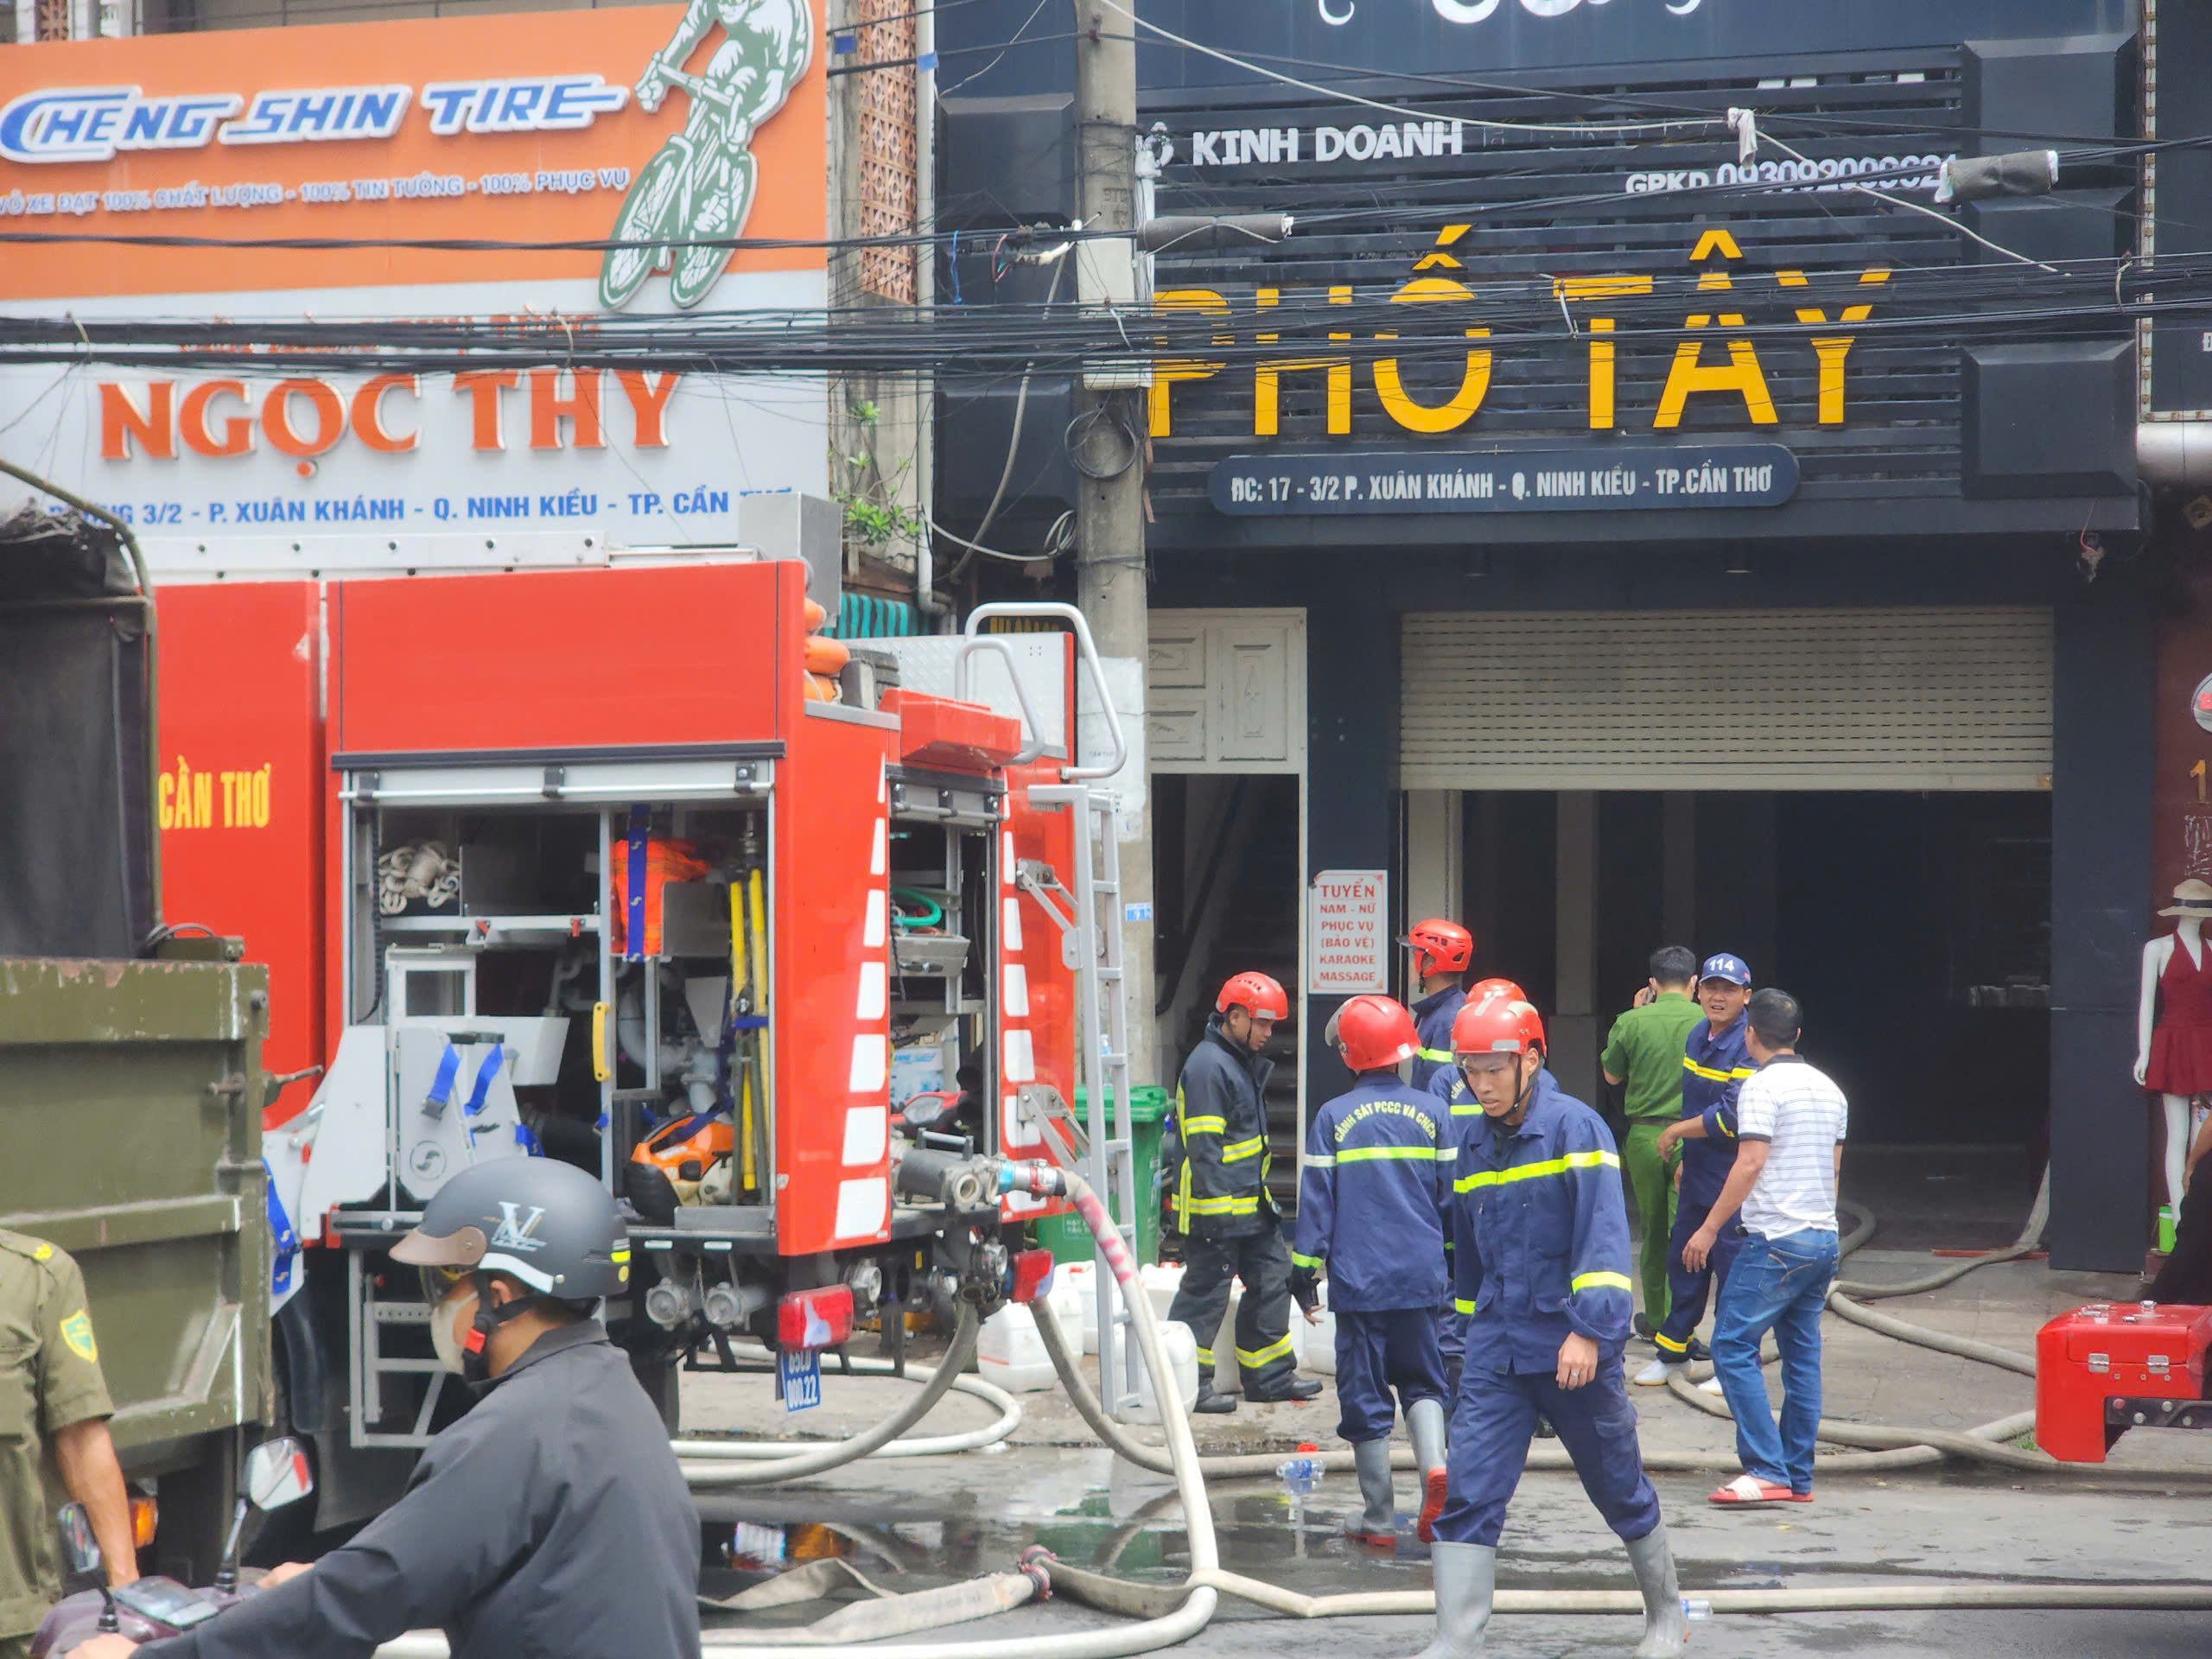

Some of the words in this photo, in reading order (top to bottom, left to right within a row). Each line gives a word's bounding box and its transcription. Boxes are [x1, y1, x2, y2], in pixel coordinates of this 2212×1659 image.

[0, 87, 241, 160] CHENG
[221, 87, 409, 143] SHIN
[424, 76, 626, 133] TIRE
[1192, 127, 1299, 166] KINH
[1315, 121, 1462, 162] DOANH
[26, 194, 56, 214] XE
[58, 192, 99, 215] ĐẠT
[103, 190, 151, 211] 100%
[154, 181, 207, 209] CHẤT
[300, 180, 350, 202] 100%
[353, 179, 389, 200] TIN
[480, 173, 533, 194] 100%
[535, 169, 596, 194] PHỤC
[597, 167, 630, 191] VỤ
[1553, 230, 1891, 430] TÂY
[99, 373, 423, 479] NGỌC
[452, 366, 687, 451] THY
[1268, 476, 1291, 501] 17
[1310, 475, 1339, 501] 3/2
[1344, 474, 1363, 500] P.
[1369, 470, 1421, 500] XUÂN
[1427, 468, 1493, 499] KHÁNH
[1512, 472, 1531, 500] Q.
[1536, 471, 1586, 497] NINH
[1733, 464, 1772, 493] THƠ
[143, 502, 182, 525] 3/2
[209, 503, 227, 524] P.
[236, 495, 305, 524] XUÂN
[315, 494, 405, 522] KHÁNH
[434, 498, 457, 521] Q.
[467, 497, 530, 518] NINH
[628, 493, 664, 515] TP.
[219, 761, 272, 829] THƠ
[1320, 878, 1376, 899] TUYỂN
[1320, 905, 1346, 913] NAM
[1359, 902, 1376, 913] NỮ
[1321, 921, 1354, 932] PHỤC
[1358, 921, 1374, 932] VỤ
[1320, 955, 1376, 964] KARAOKE
[1710, 958, 1734, 971] 114
[1320, 972, 1376, 982] MASSAGE
[1374, 1101, 1402, 1115] PCCC
